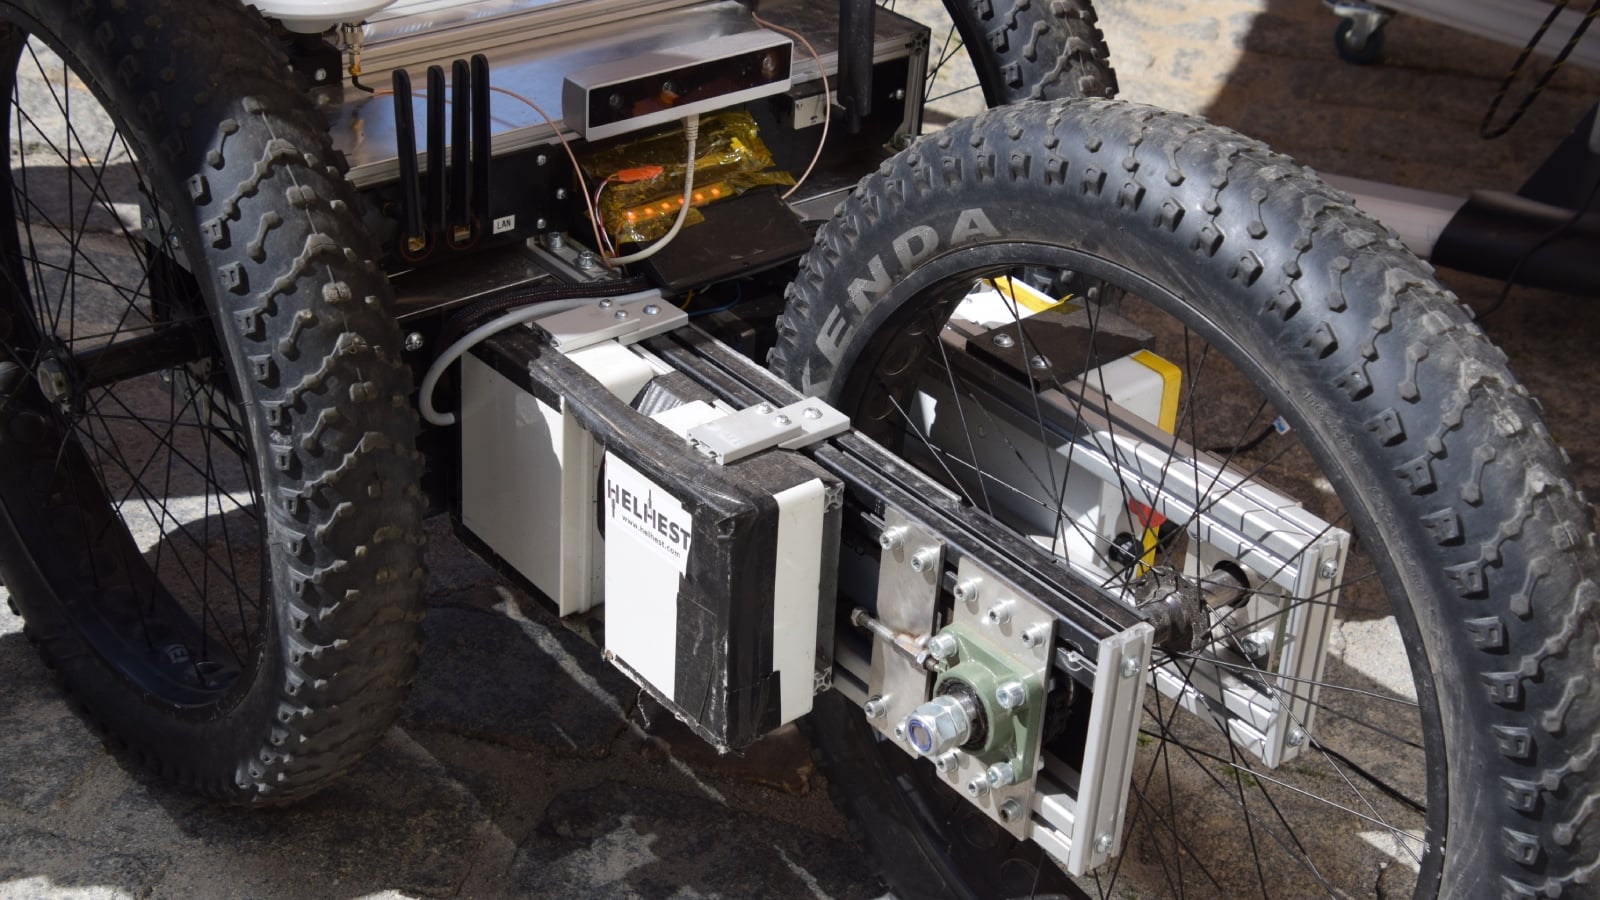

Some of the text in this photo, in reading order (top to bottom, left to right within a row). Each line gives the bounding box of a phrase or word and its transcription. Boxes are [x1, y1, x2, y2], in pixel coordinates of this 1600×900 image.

[497, 219, 511, 230] LAN
[607, 479, 691, 551] HELHEST
[622, 515, 681, 558] www.helhest.com
